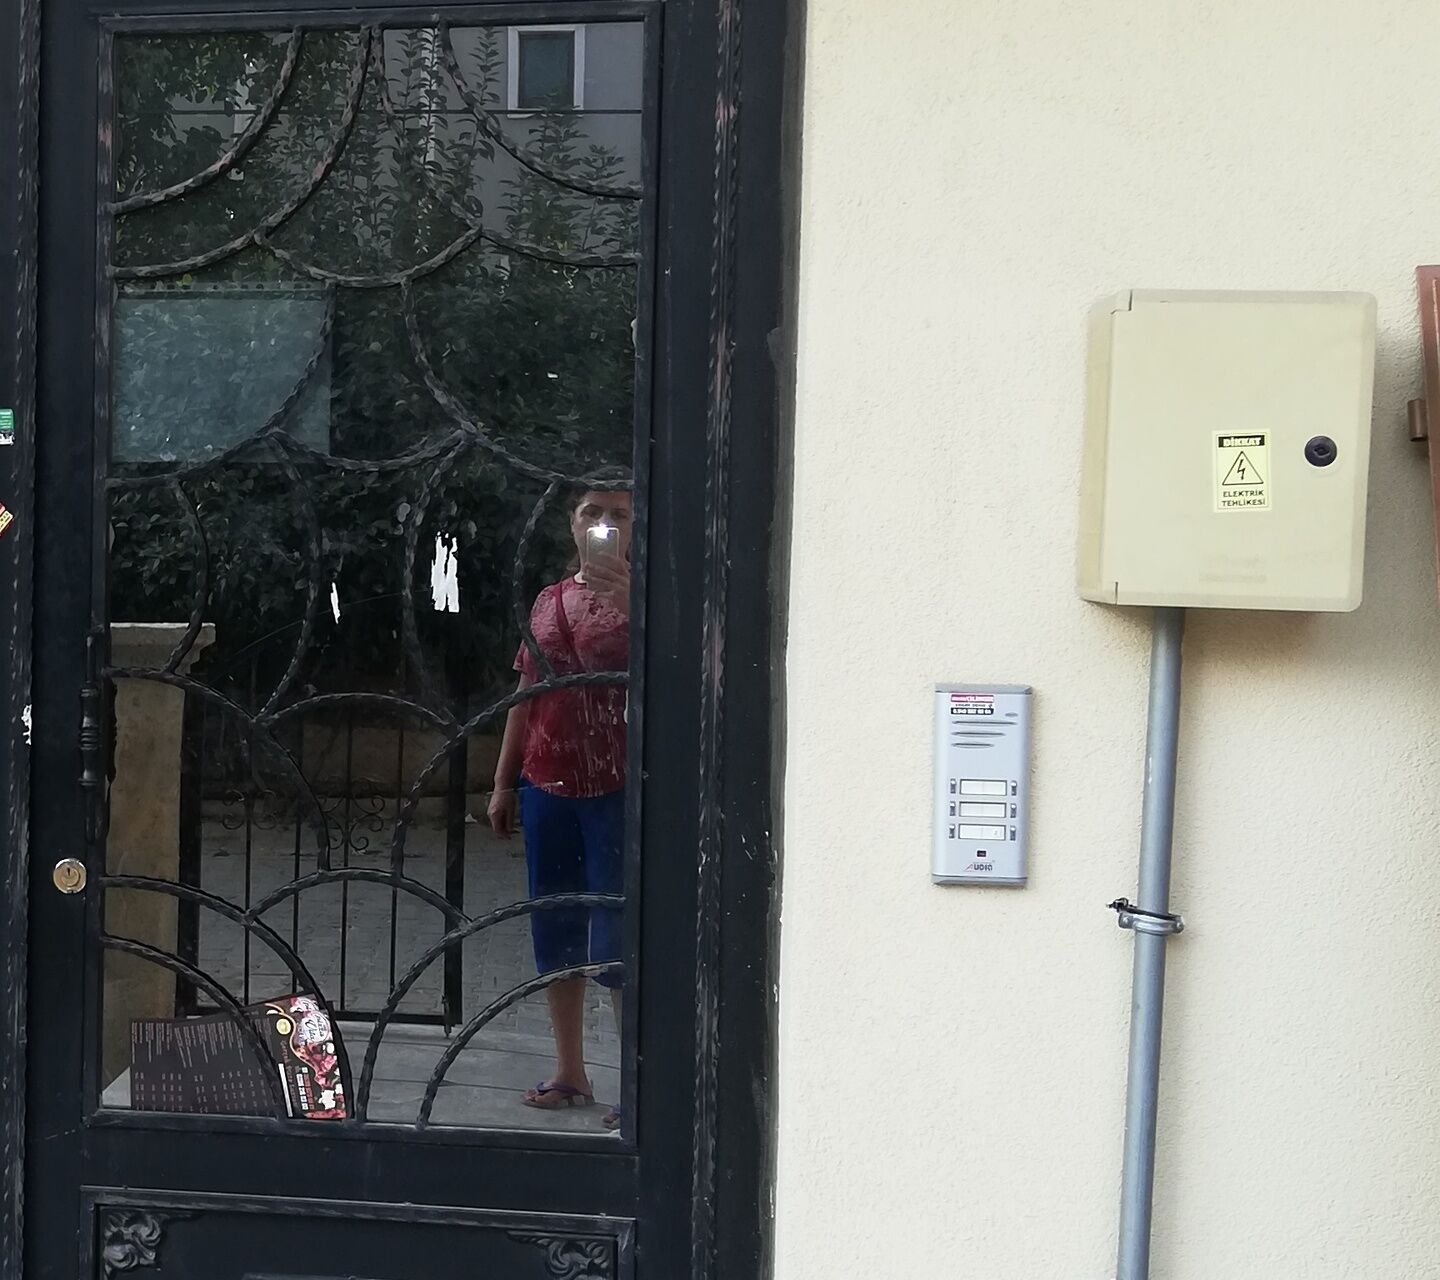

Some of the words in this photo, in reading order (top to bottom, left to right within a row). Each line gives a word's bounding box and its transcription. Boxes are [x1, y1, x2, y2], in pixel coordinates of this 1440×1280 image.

[1222, 436, 1262, 448] DİKKAT
[1222, 489, 1265, 498] ELEKTRİK
[1221, 498, 1266, 507] TEHLİKESİ
